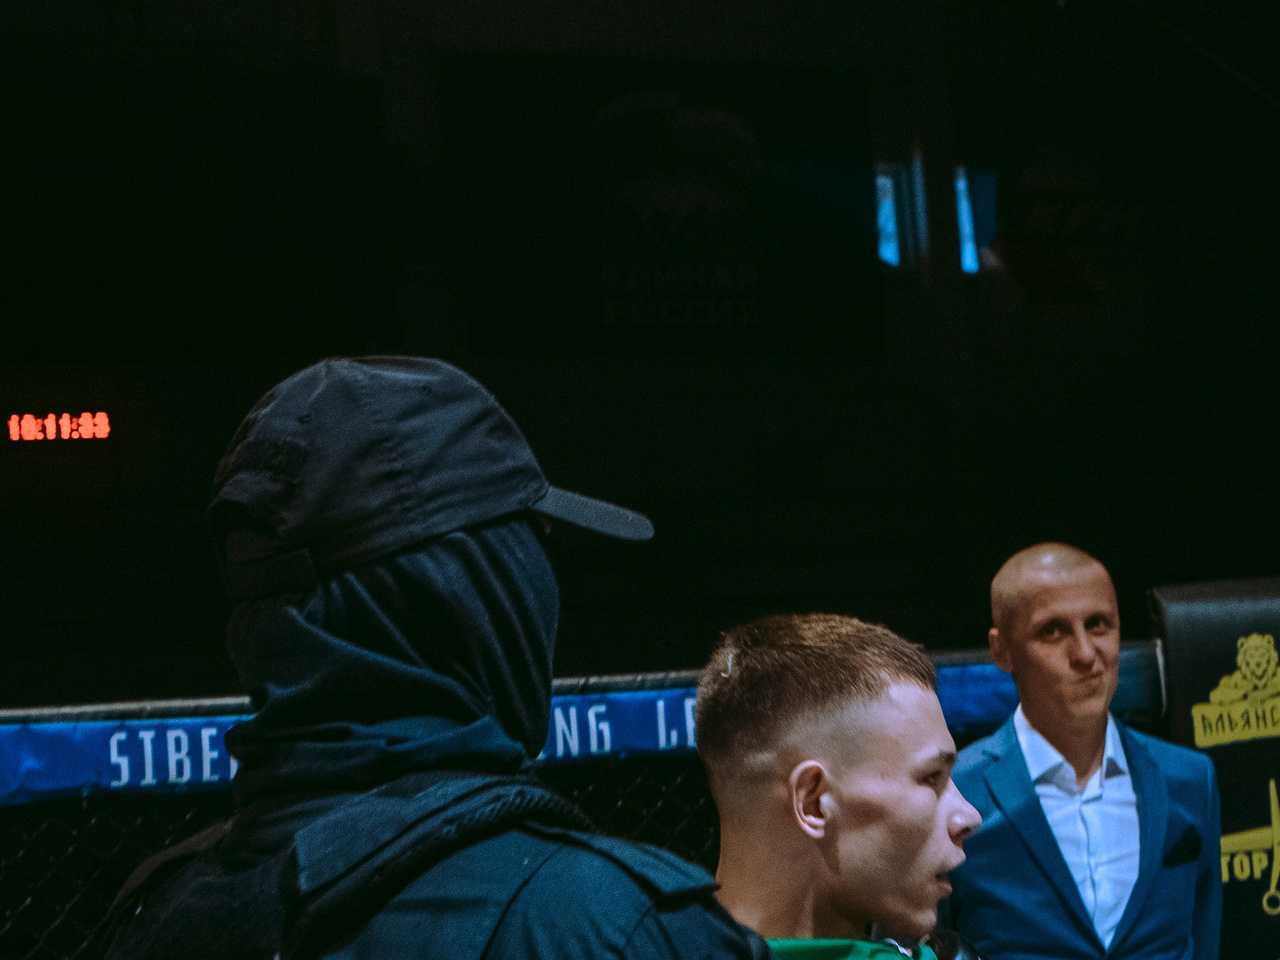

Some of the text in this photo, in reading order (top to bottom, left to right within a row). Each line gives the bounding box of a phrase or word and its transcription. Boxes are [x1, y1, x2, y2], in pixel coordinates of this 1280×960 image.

[109, 727, 239, 788] SIBE
[539, 701, 612, 761] NG
[1220, 850, 1269, 884] TOP
